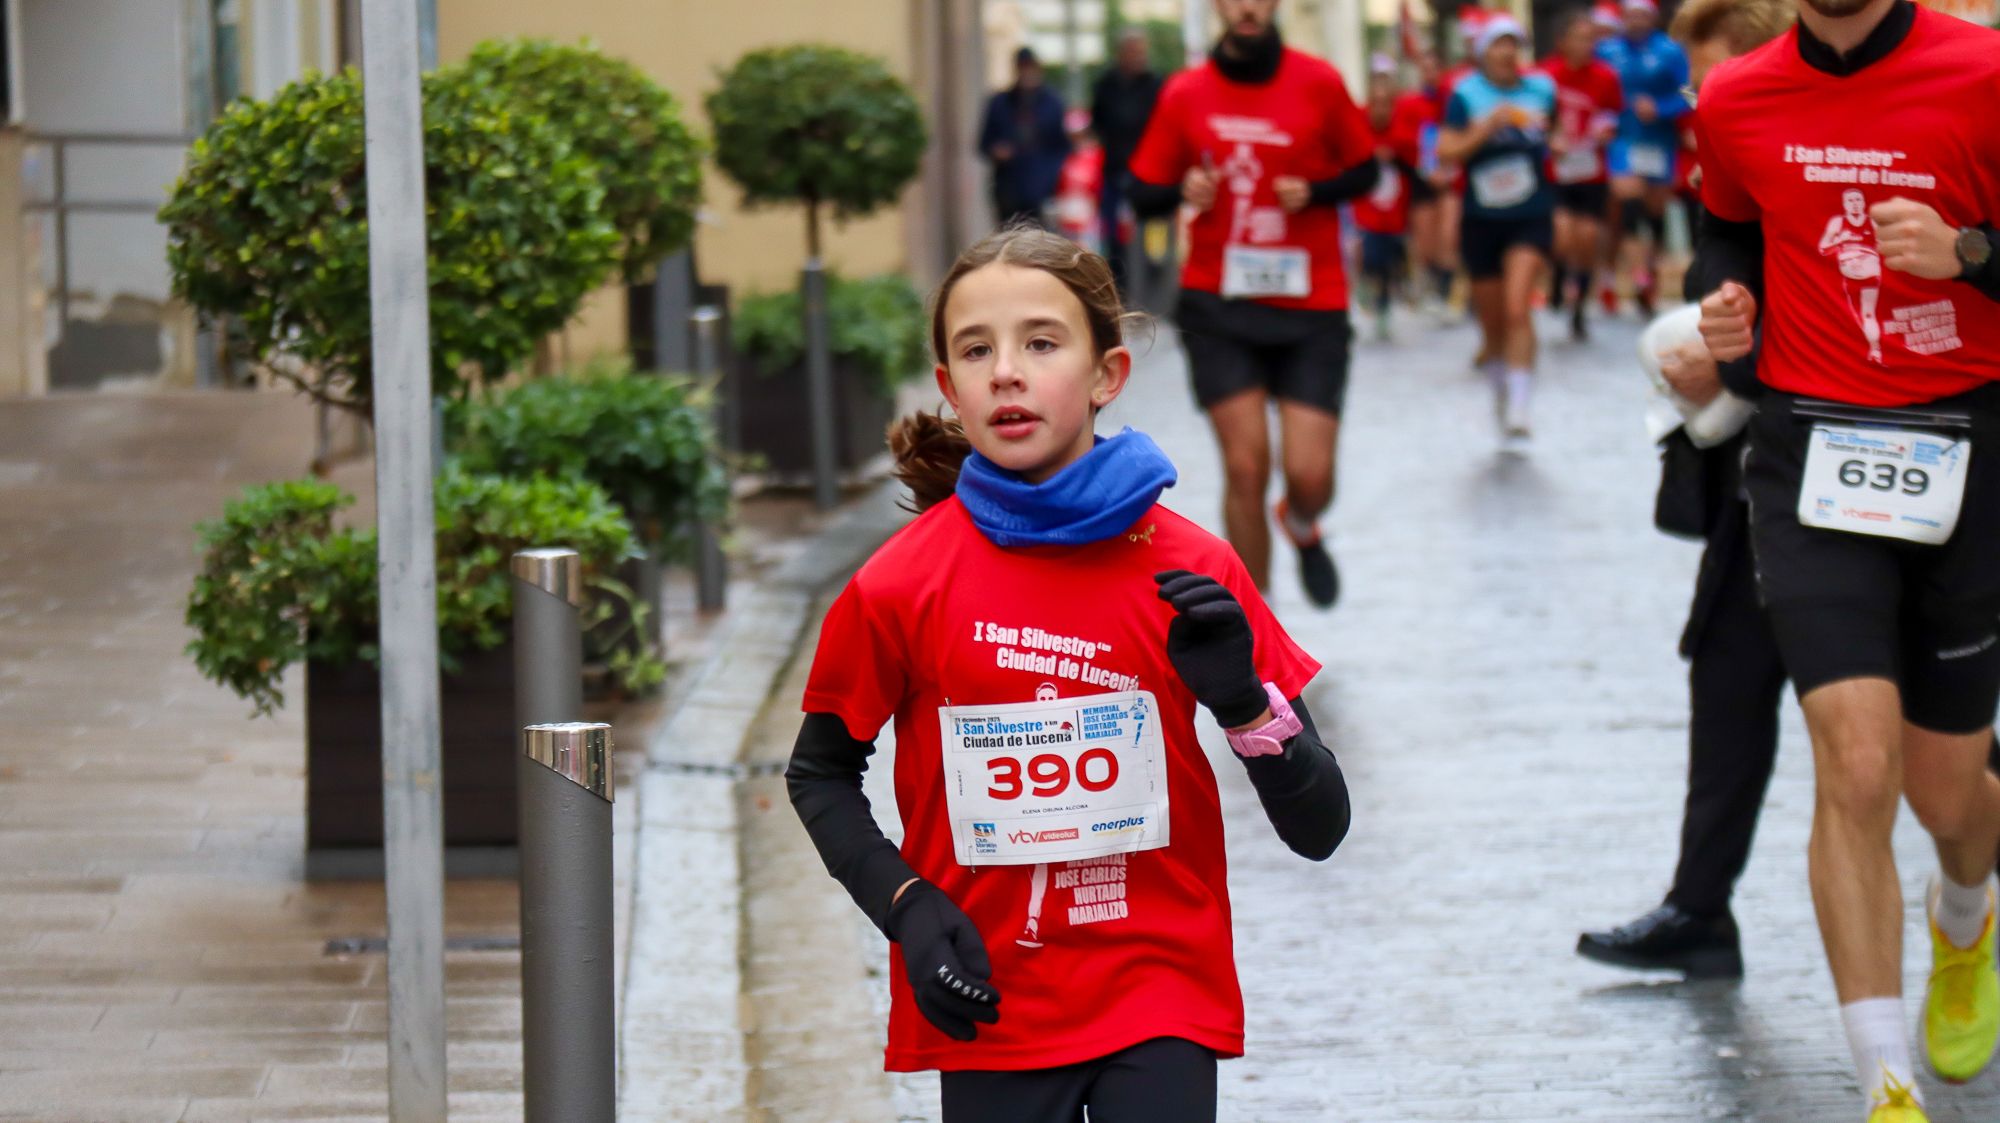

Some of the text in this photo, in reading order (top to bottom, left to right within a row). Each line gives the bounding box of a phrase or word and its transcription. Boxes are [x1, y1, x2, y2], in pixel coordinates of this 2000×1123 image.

[1838, 459, 1931, 497] 639
[973, 621, 984, 642] I
[986, 622, 1019, 646] San
[1021, 627, 1096, 660] Silvestre
[996, 647, 1139, 692] Ciudad de Lucena
[1082, 704, 1119, 716] MEMORIAL
[1101, 711, 1129, 722] CARLOS
[963, 723, 985, 735] San
[987, 721, 1043, 735] Silvestre
[1083, 721, 1117, 732] HURTADO
[963, 731, 1073, 749] Ciudad de Lucena
[986, 747, 1119, 801] 390
[1042, 831, 1076, 840] videoluc
[1091, 816, 1145, 831] enerplus
[1055, 866, 1127, 890] JOSE CARLOS
[1073, 882, 1126, 906] HURTADO
[1067, 900, 1128, 926] MARJALIZO
[937, 964, 989, 1002] KIPSTA
